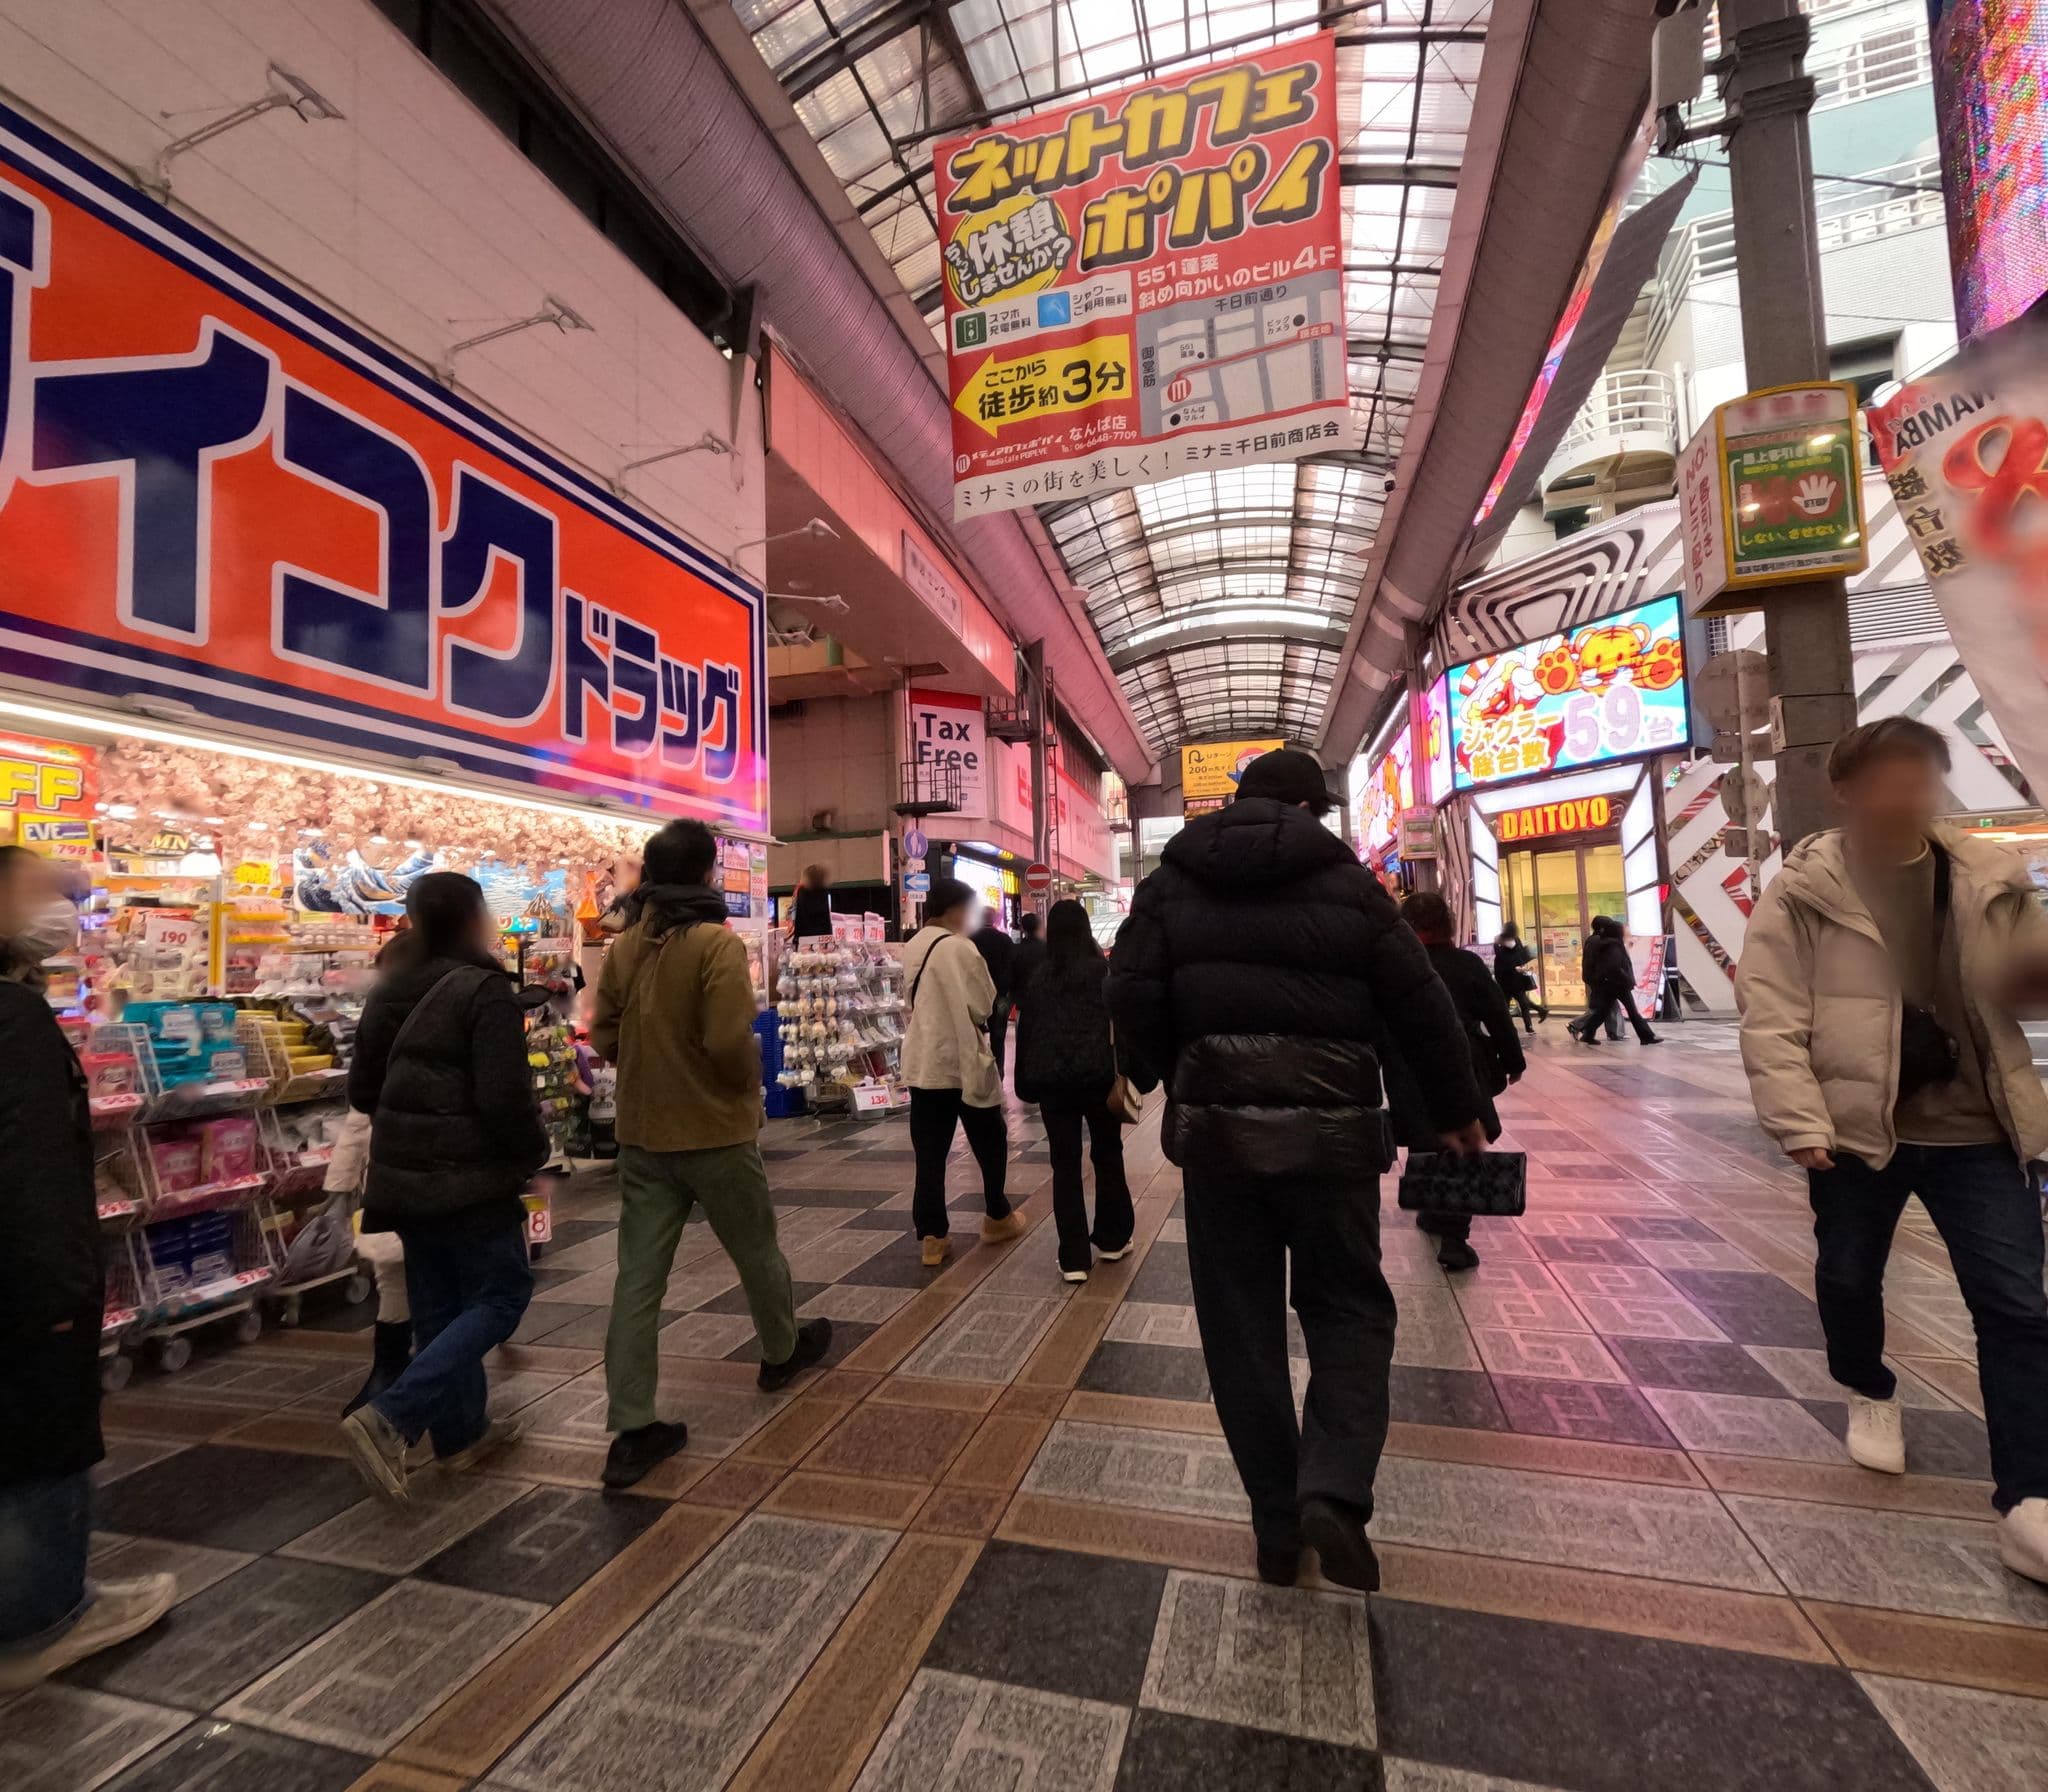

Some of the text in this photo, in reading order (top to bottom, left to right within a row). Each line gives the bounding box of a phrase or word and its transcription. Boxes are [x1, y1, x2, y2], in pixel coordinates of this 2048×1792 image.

[949, 62, 1320, 212] ネットカフェ
[1081, 142, 1326, 270] ポパイ
[967, 202, 1058, 270] 休憩
[1214, 284, 1288, 312] 千日前通り
[988, 308, 1020, 324] スマホ
[989, 317, 1031, 337] 充電無料
[985, 359, 1048, 388] ここから
[978, 359, 1127, 420] 徒歩約3分
[1069, 415, 1127, 441] なんば店
[1186, 422, 1341, 462] ミナミ千日前商店会
[0, 190, 742, 783] イコクドラッグ
[920, 712, 971, 743] Tax
[917, 740, 979, 770] Free
[1501, 796, 1610, 841] DAITOYO
[159, 930, 188, 946] 190
